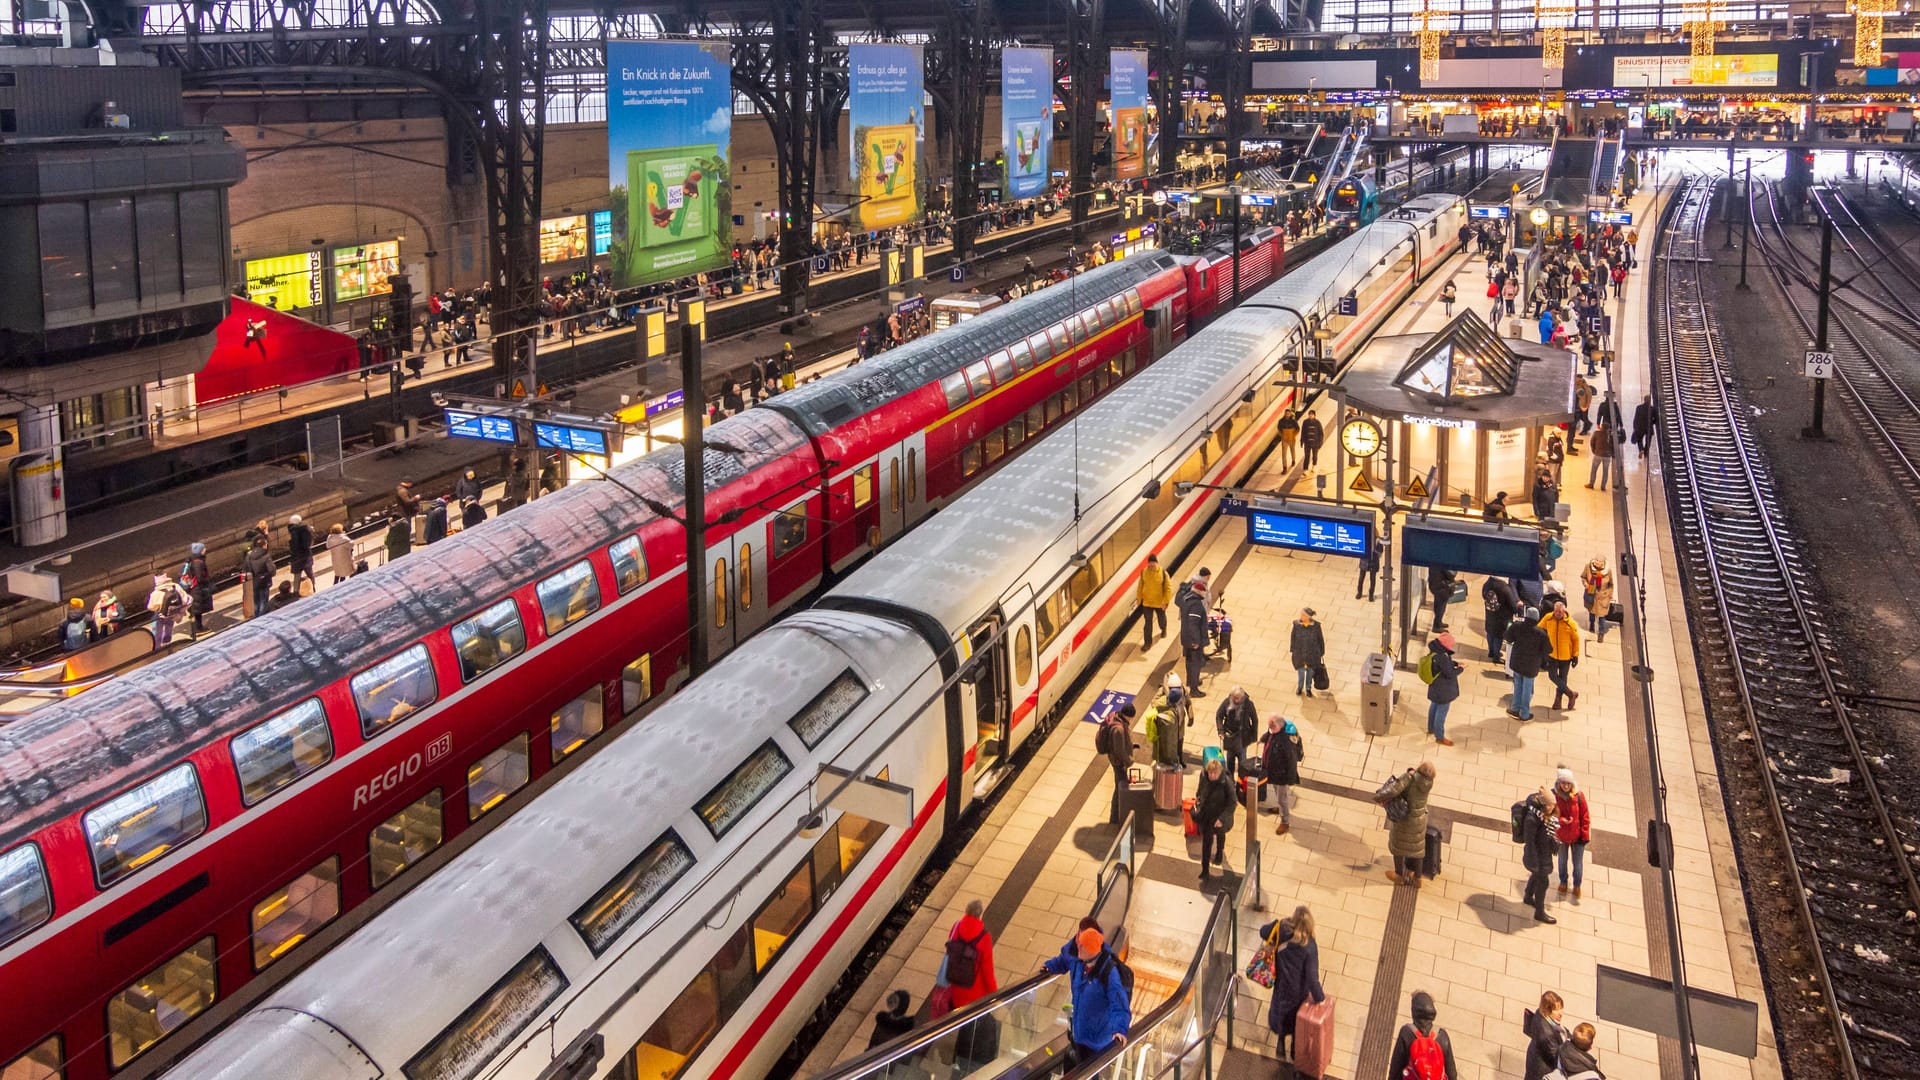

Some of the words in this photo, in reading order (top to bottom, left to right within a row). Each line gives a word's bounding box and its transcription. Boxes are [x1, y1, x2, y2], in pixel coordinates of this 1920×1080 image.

[622, 68, 635, 80] Ein
[636, 67, 659, 80] Knick
[660, 67, 668, 80] in
[668, 67, 681, 80] die
[682, 66, 712, 80] Zukunft.
[818, 258, 826, 270] D
[953, 267, 962, 280] D
[1341, 300, 1350, 313] E
[1808, 352, 1831, 365] 286
[1814, 365, 1823, 375] 6
[1403, 414, 1461, 429] ServiceStore
[352, 752, 422, 811] REGIO
[427, 734, 451, 763] DB
